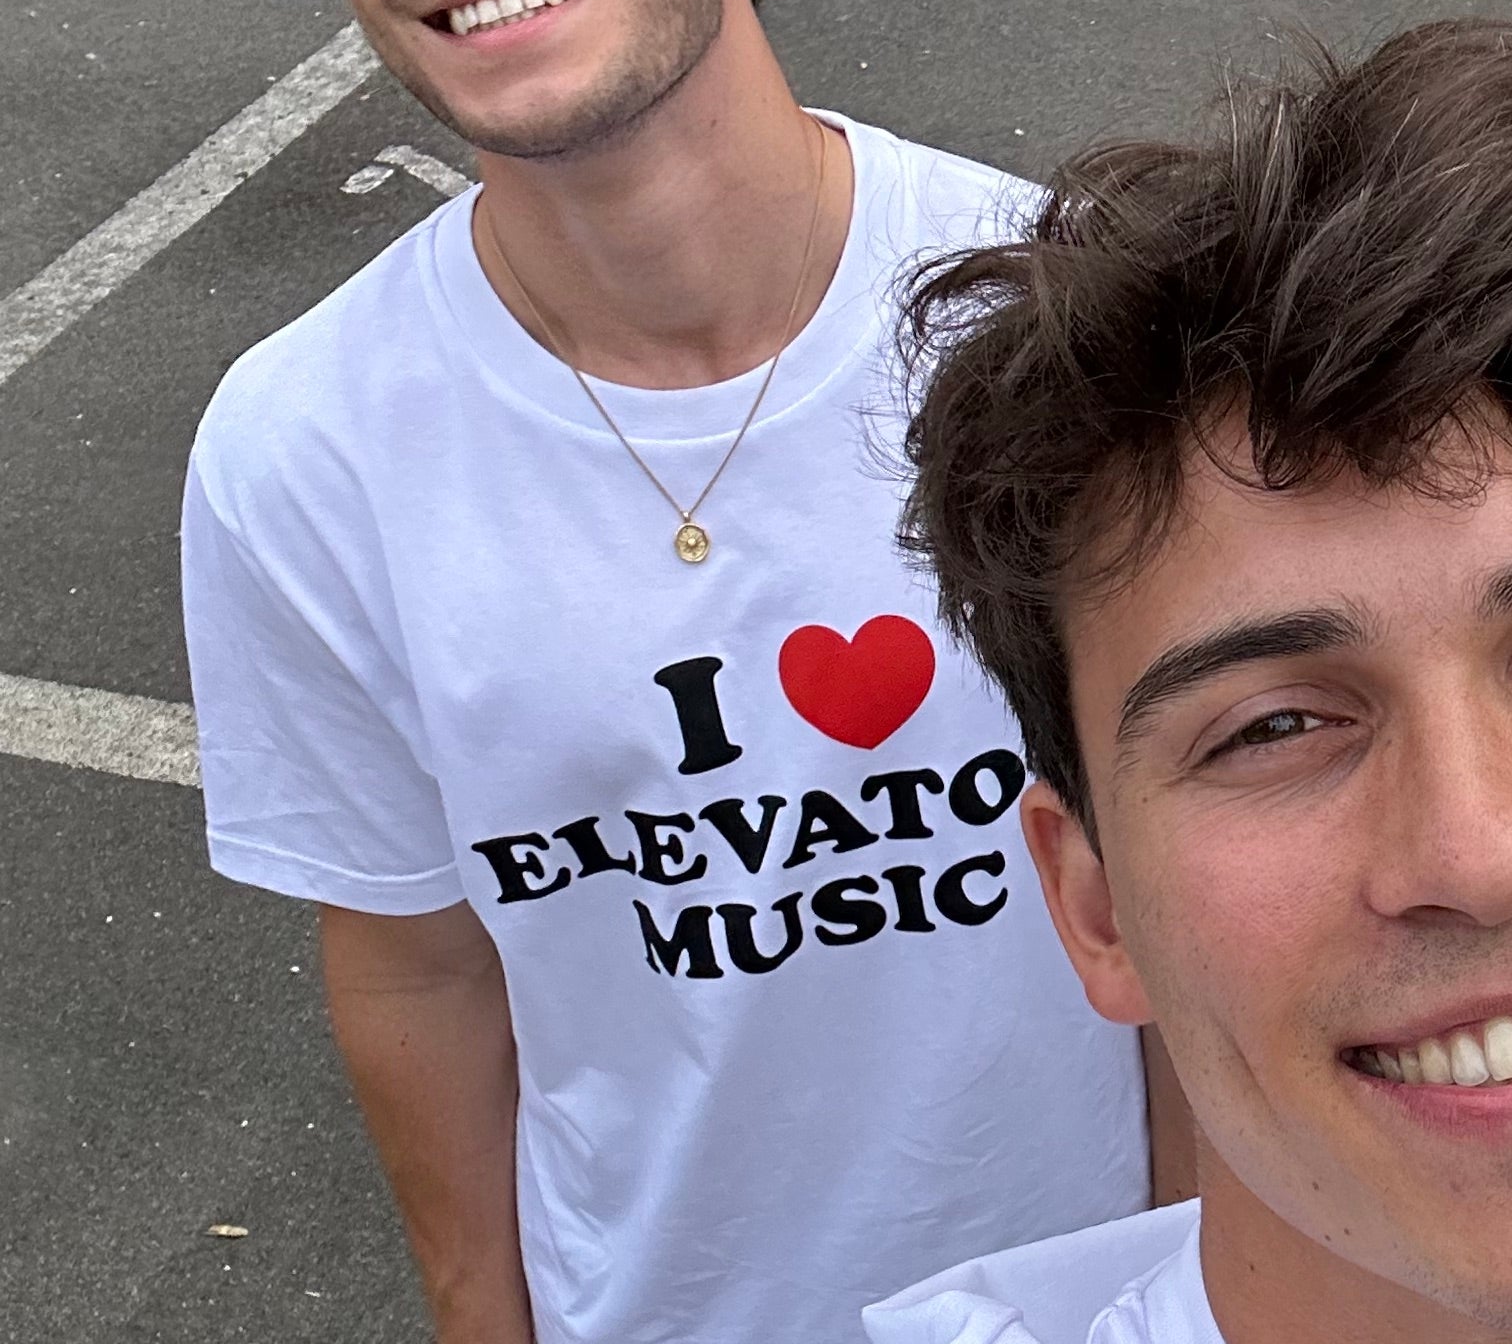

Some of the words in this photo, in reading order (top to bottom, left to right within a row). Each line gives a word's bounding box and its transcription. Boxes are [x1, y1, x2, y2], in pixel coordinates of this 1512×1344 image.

[653, 656, 743, 776] I
[470, 748, 1026, 905] ELEVATO
[632, 850, 1009, 979] MUSIC
